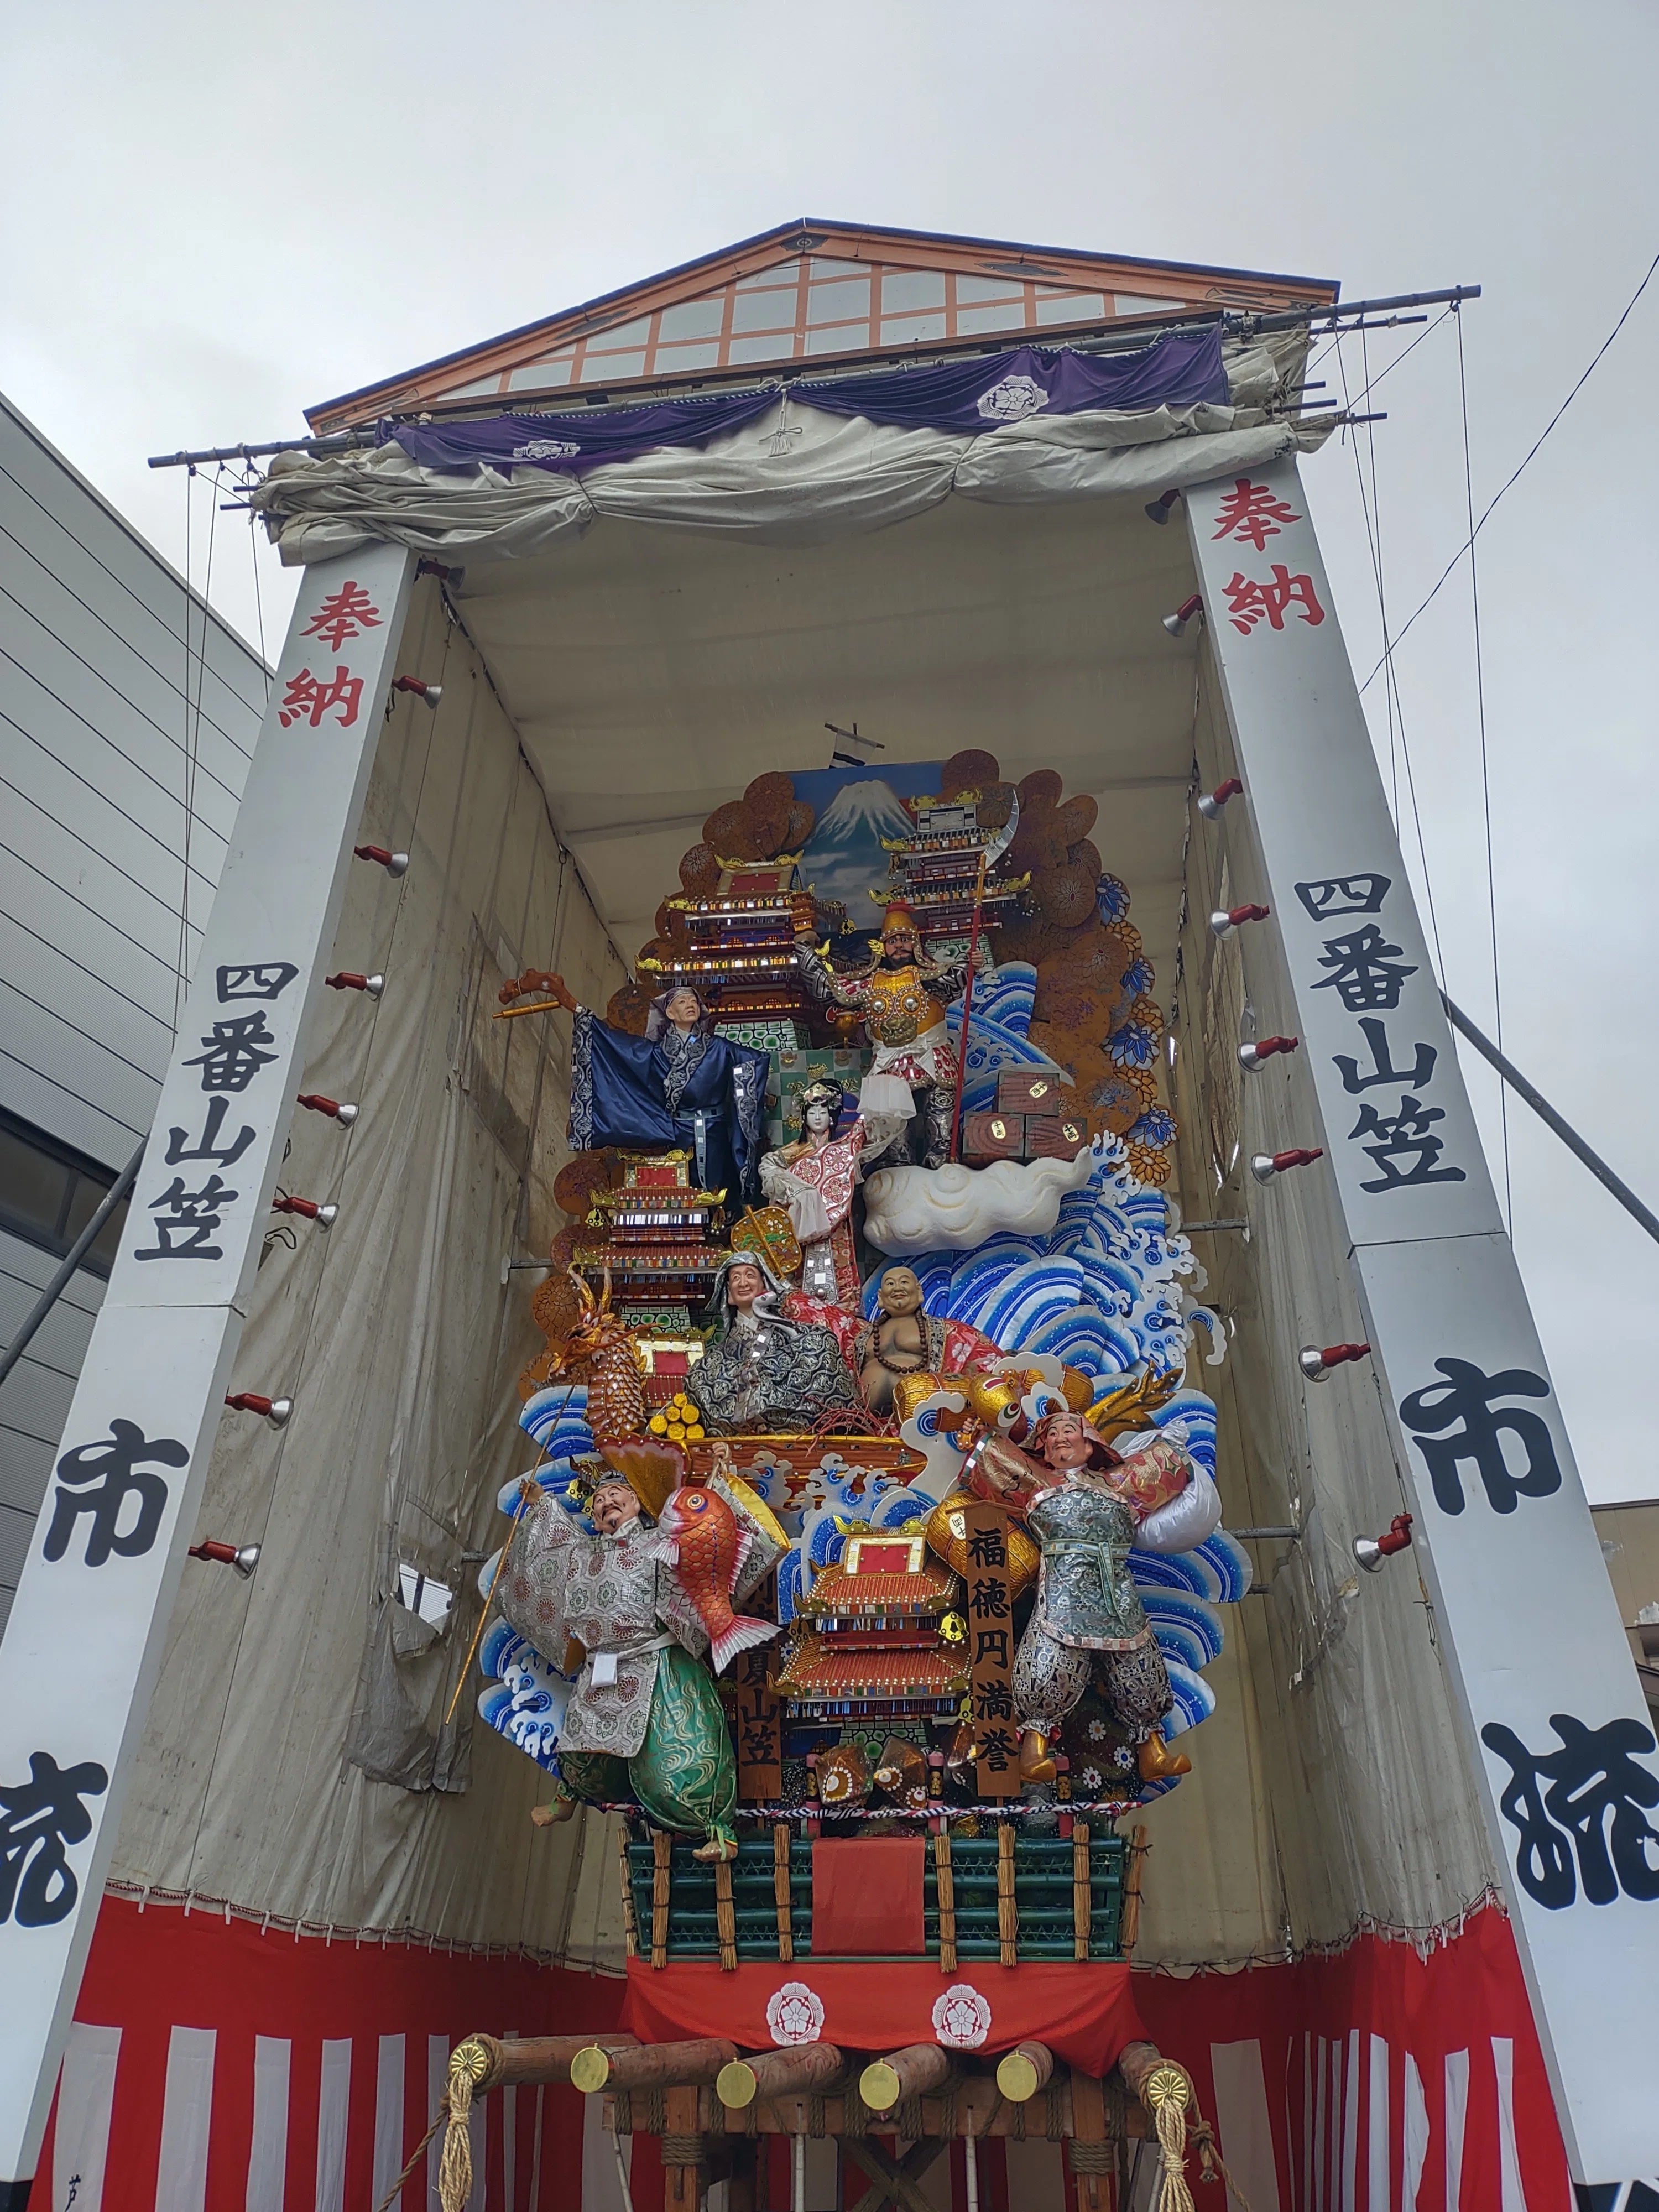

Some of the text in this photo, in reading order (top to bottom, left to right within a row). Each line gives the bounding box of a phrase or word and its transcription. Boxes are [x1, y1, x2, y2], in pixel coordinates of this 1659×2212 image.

[1212, 478, 1326, 635] 奉納
[278, 580, 385, 729] 奉納
[133, 961, 299, 1262] 四番山笠
[1293, 872, 1467, 1194] 四番山笠
[994, 1121, 1004, 1136] 千両
